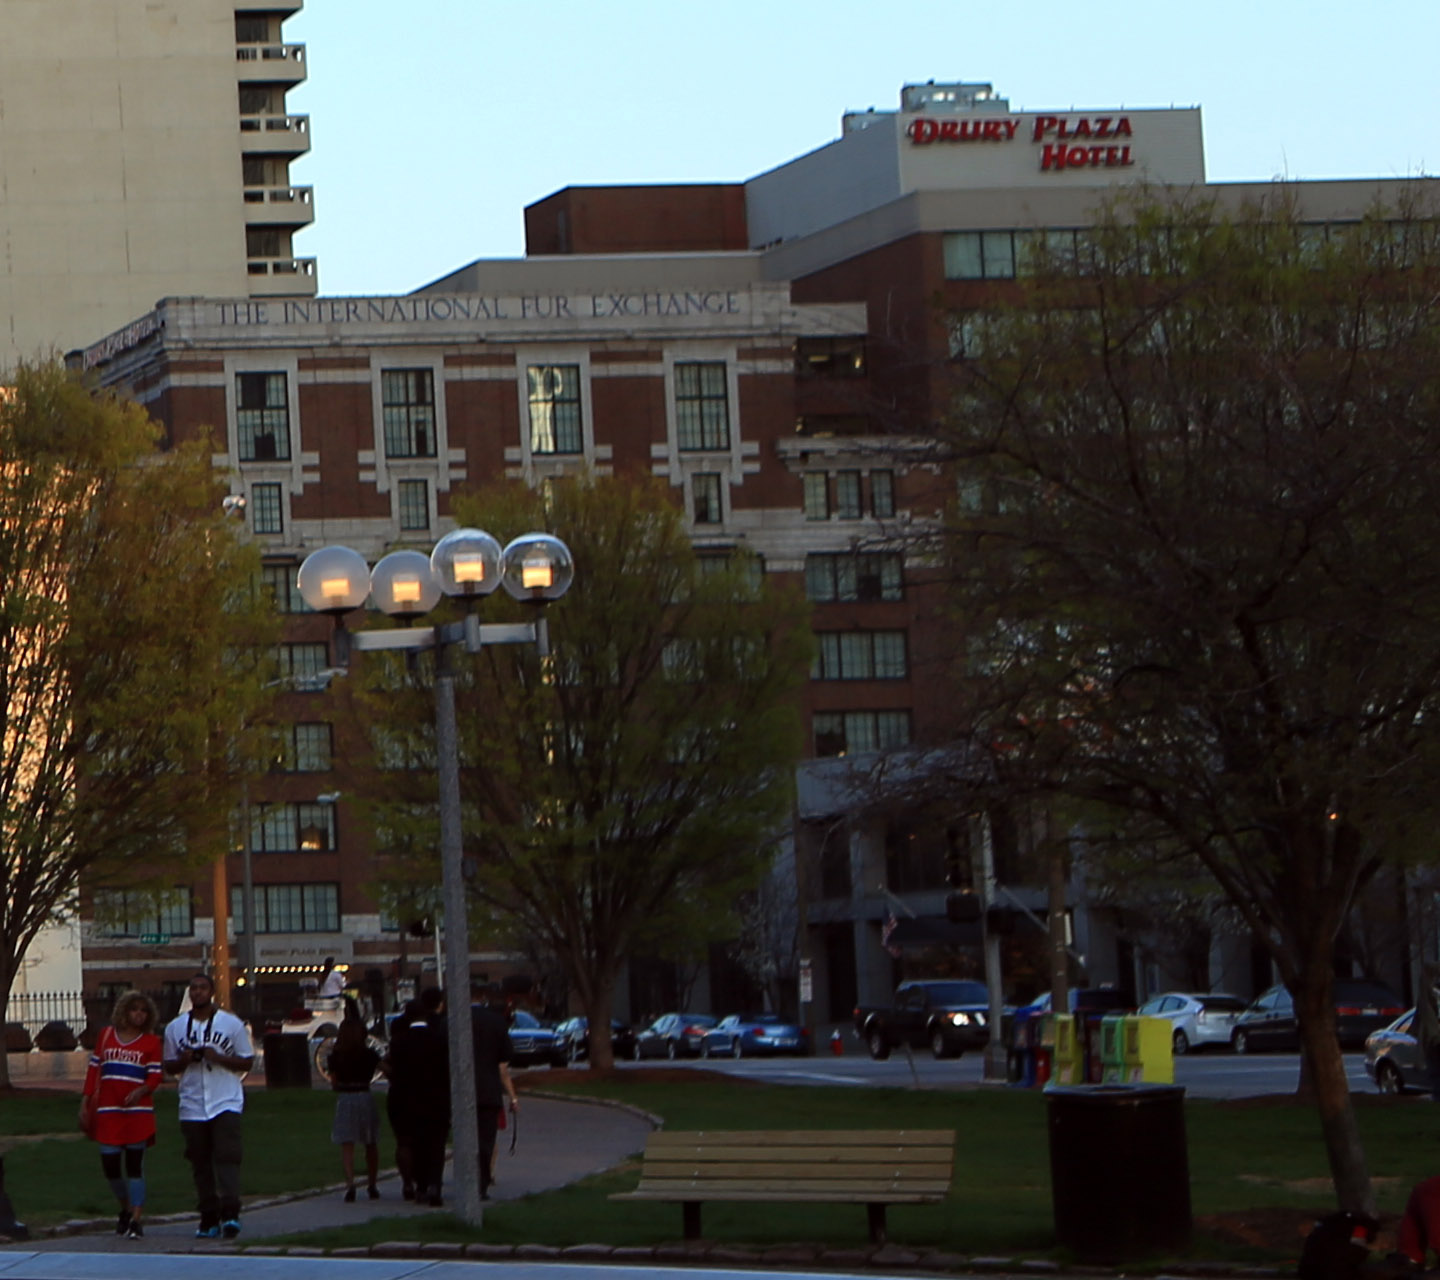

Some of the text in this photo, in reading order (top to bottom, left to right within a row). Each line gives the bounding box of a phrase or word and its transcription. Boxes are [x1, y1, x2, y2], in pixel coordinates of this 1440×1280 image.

[907, 115, 1133, 146] DRURY PLAZA
[1039, 143, 1135, 171] HOTEL
[216, 291, 740, 326] THE INTERNATIONAL FUR EXCHANGE
